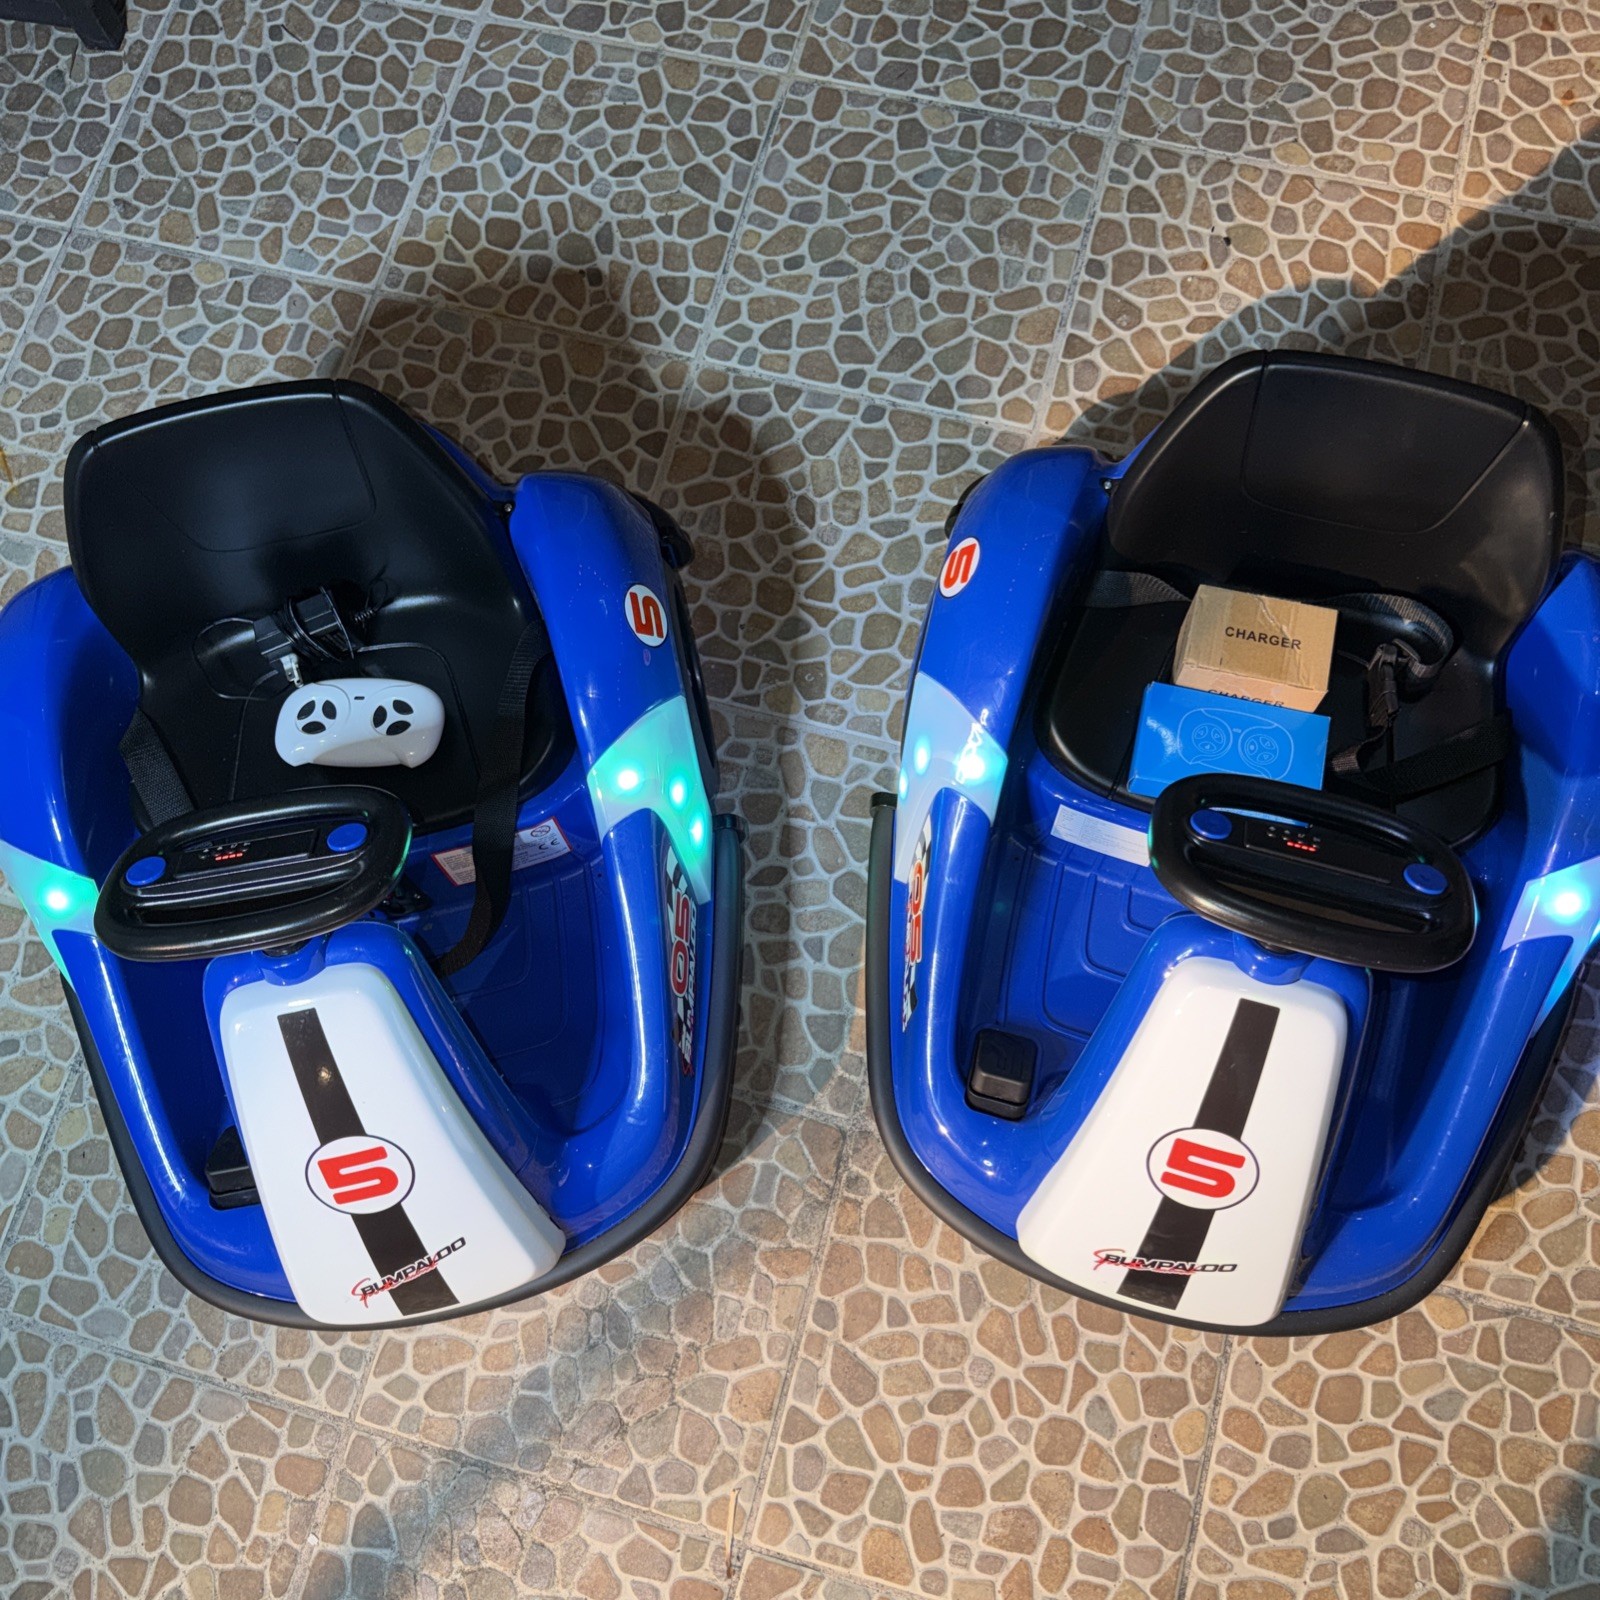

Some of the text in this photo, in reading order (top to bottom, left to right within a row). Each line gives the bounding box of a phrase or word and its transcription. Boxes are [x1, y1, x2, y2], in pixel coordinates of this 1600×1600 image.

[944, 543, 977, 589] 5
[629, 592, 664, 638] 5
[1225, 627, 1301, 650] CHARGER
[671, 889, 691, 997] 05
[317, 1146, 399, 1205] 5
[1160, 1138, 1246, 1198] 5
[359, 1236, 467, 1298] BUMPALOO
[1102, 1252, 1238, 1274] BUMPALOO
